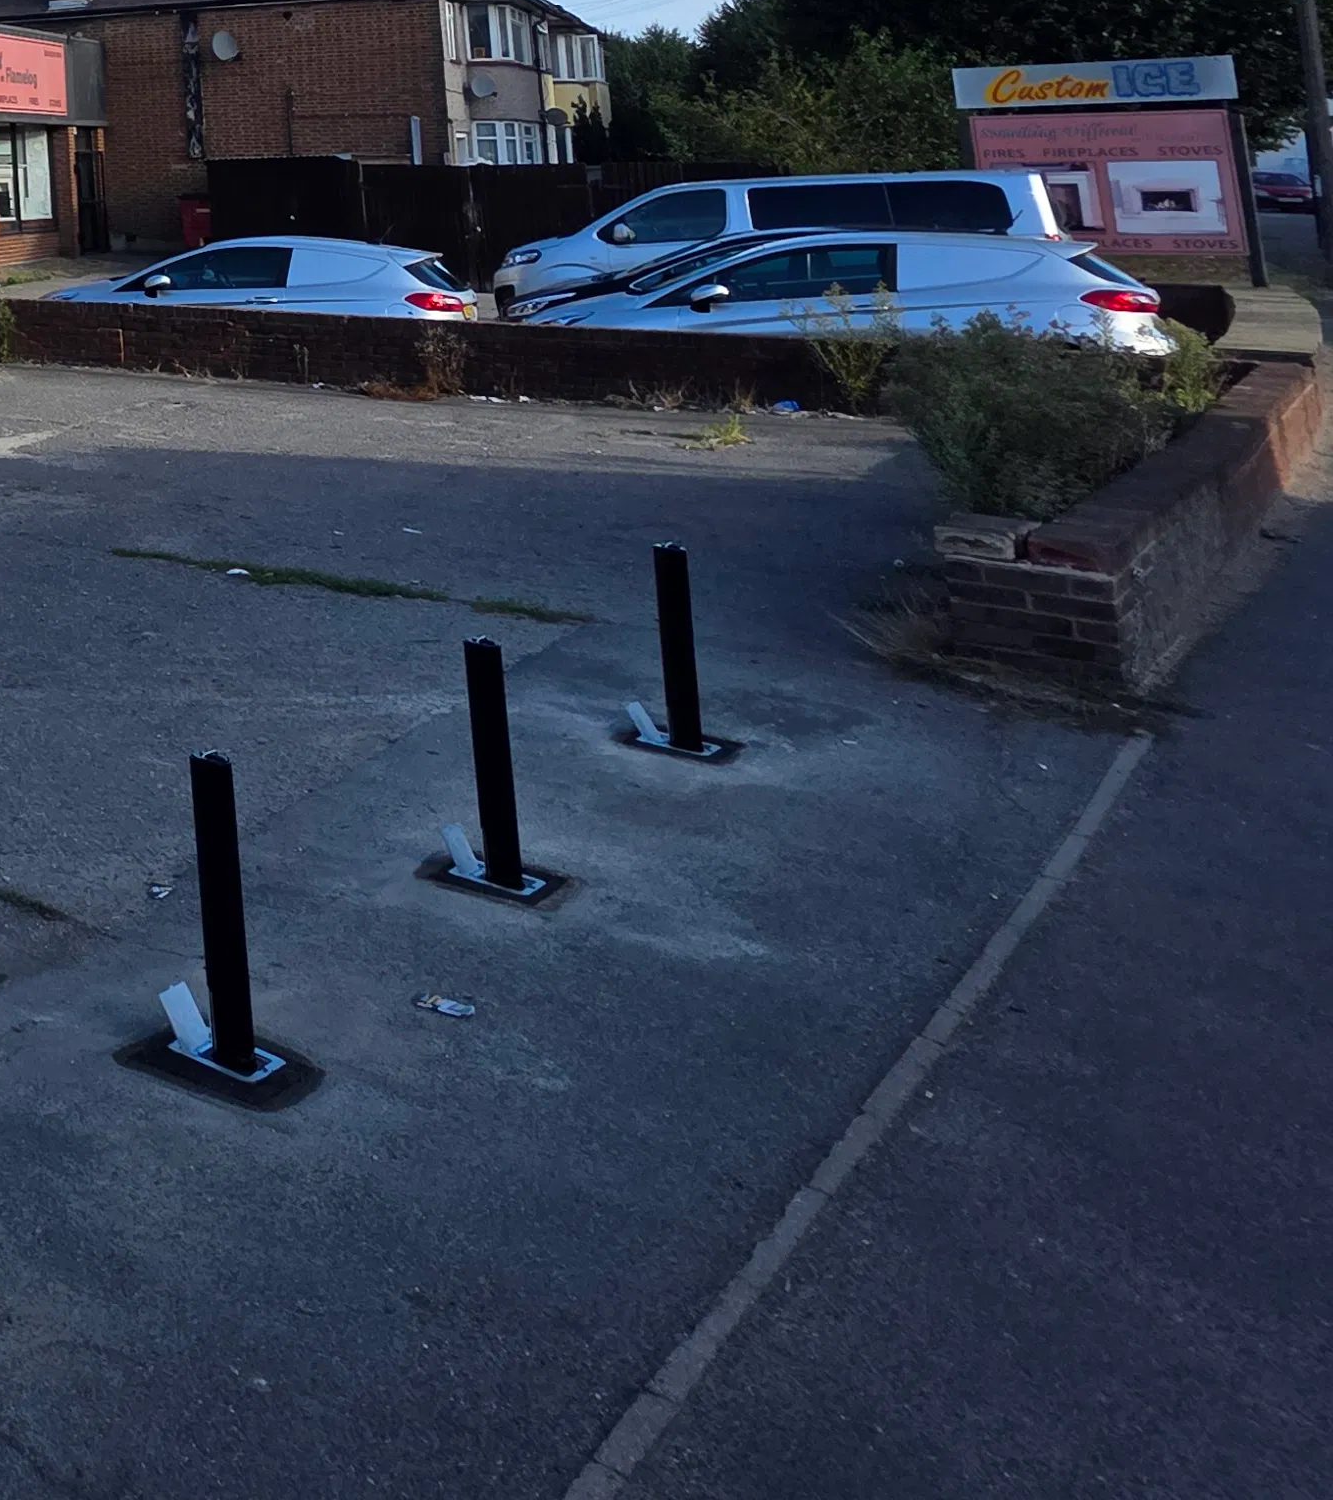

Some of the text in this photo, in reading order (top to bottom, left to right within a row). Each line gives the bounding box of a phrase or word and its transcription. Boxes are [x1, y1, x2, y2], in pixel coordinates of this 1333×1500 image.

[986, 61, 1202, 104] Custom ICE
[983, 145, 1224, 158] FIRES FIREPLACES STOVES
[1172, 238, 1240, 249] STOVES
